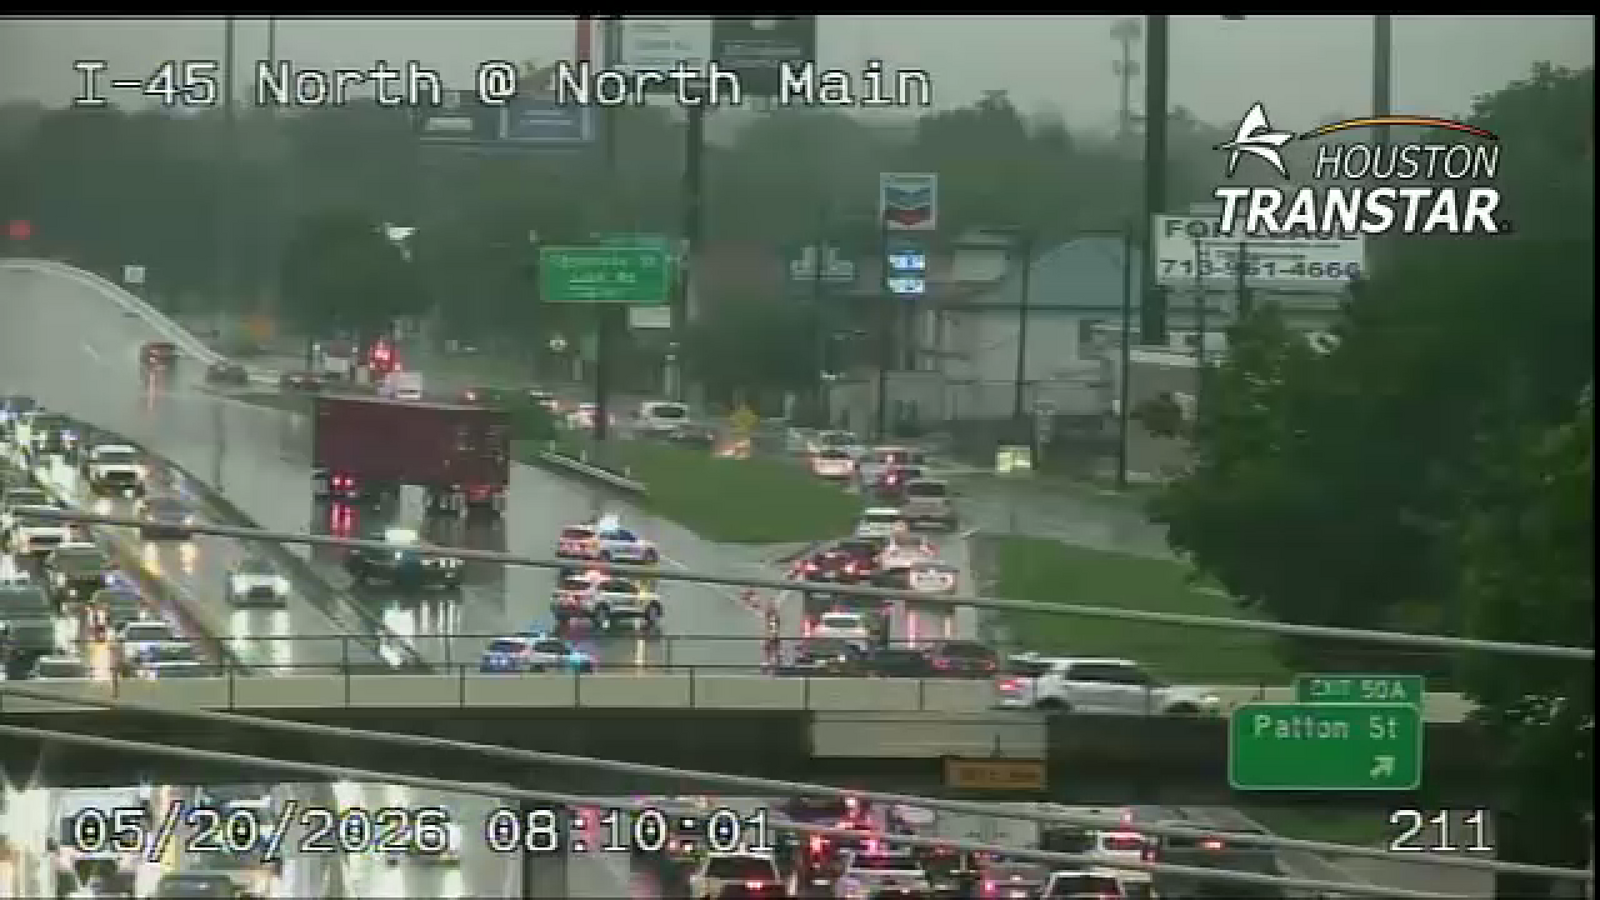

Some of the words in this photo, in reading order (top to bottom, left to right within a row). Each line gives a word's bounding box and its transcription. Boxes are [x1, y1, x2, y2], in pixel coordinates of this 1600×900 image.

[1360, 679, 1406, 699] 50A
[1253, 714, 1350, 739] Patton
[1369, 714, 1399, 739] St
